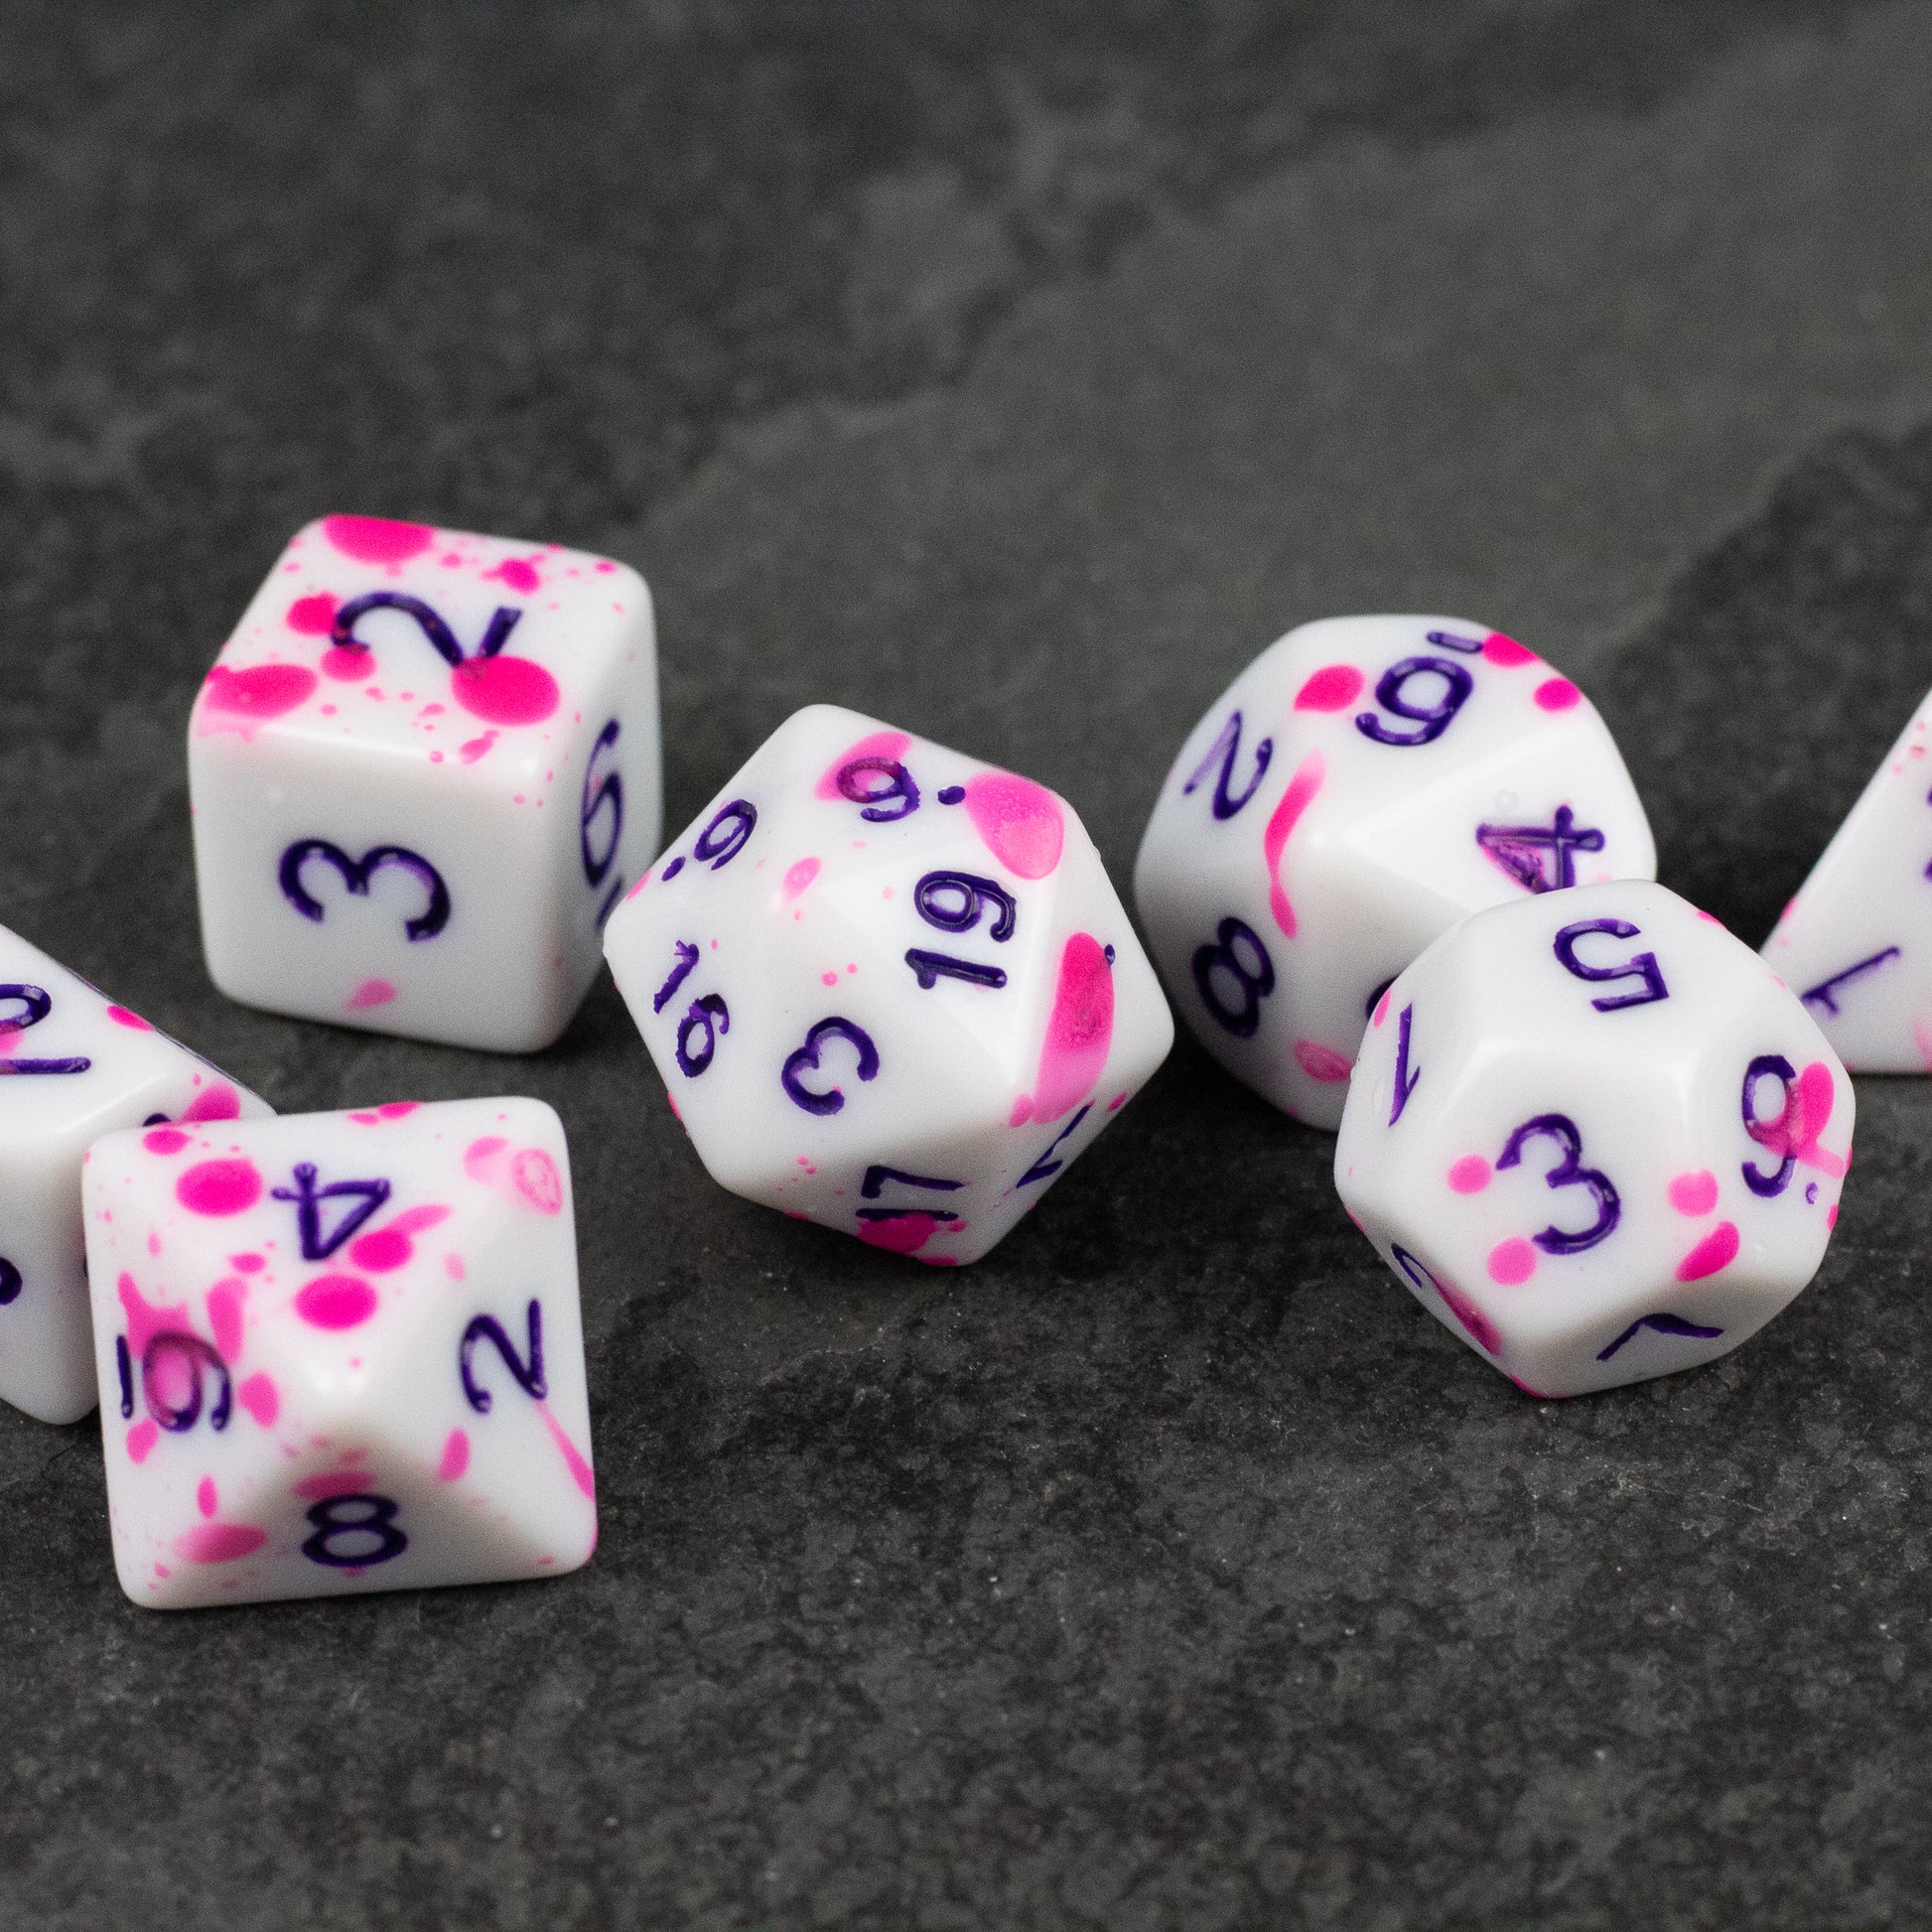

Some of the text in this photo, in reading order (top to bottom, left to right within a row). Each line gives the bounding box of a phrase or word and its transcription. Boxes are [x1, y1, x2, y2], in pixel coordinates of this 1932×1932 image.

[332, 591, 523, 682] 2
[1182, 709, 1275, 822] 2
[277, 839, 451, 943] 3
[1475, 803, 1606, 895] 4
[904, 870, 1017, 990] 19
[1192, 915, 1276, 1038] 8
[1552, 916, 1670, 1014] 5
[652, 938, 731, 1079] 16
[780, 1015, 881, 1117] 3
[1388, 1003, 1422, 1129] 1
[270, 1162, 392, 1262] 4
[1495, 1113, 1622, 1257] 3
[459, 1298, 549, 1416] 2
[301, 1493, 408, 1569] 8
